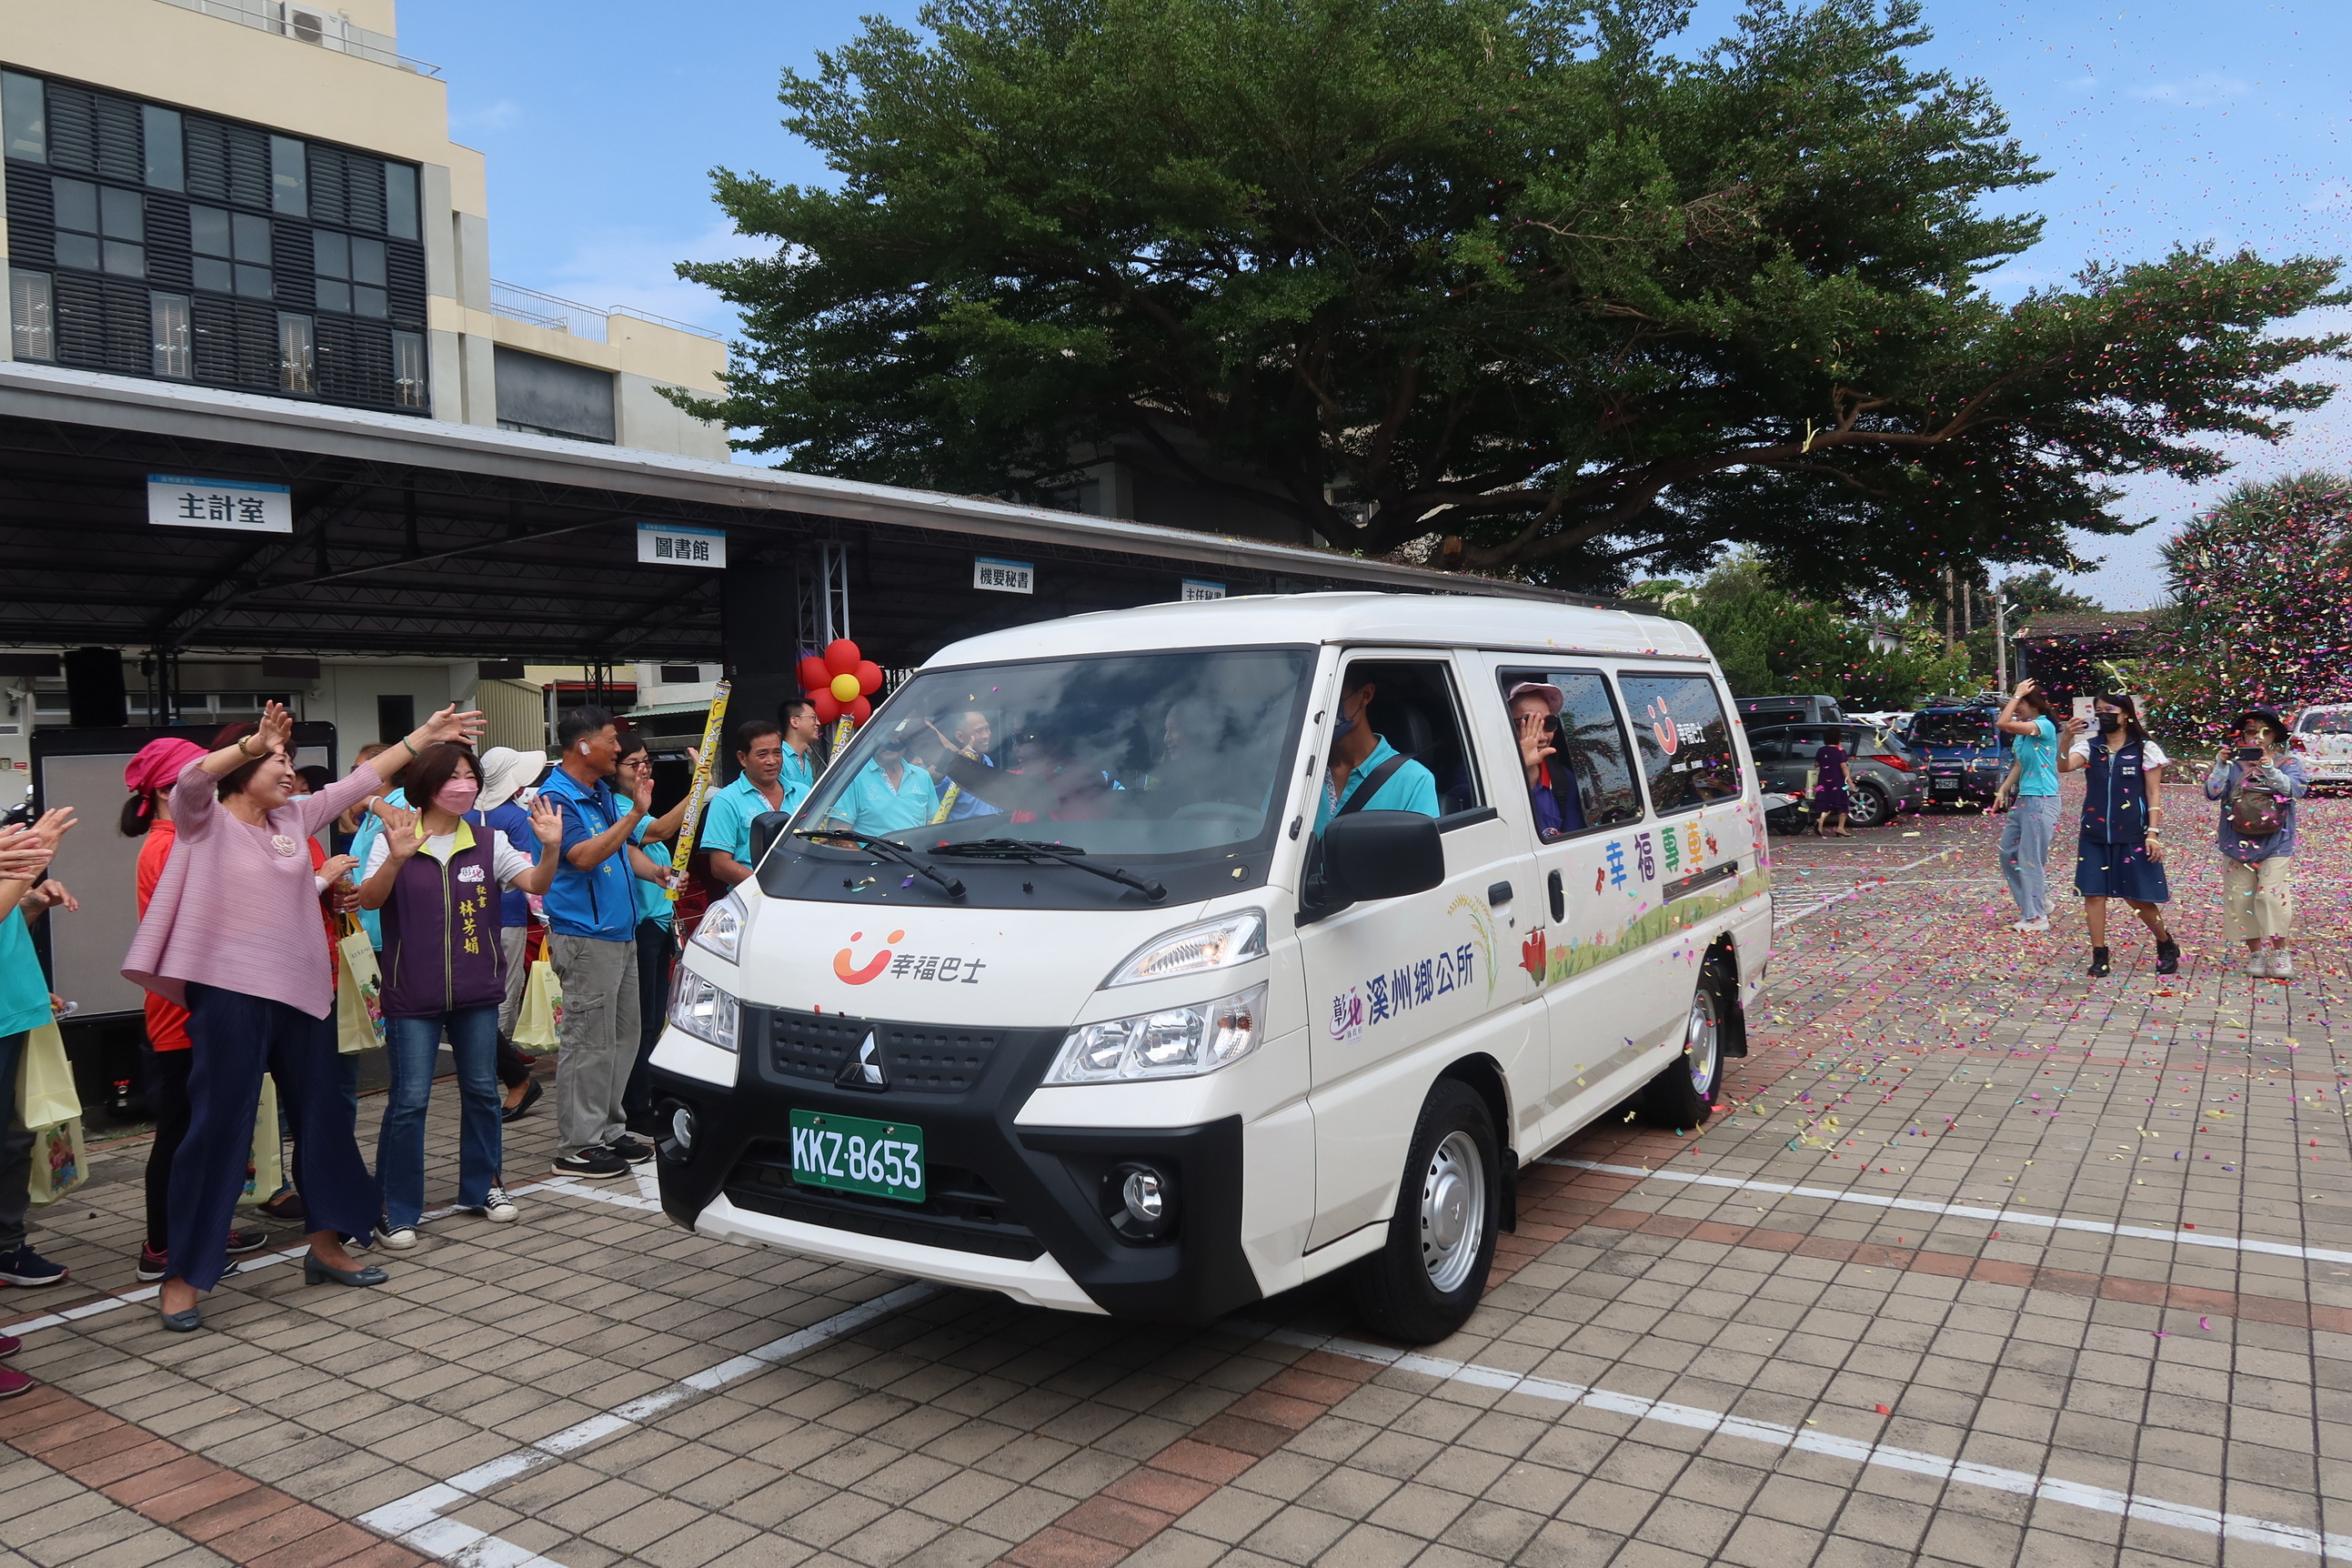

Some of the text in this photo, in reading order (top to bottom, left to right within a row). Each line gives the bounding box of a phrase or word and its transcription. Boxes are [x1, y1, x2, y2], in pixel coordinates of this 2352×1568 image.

[177, 492, 266, 524] 主計室
[656, 537, 709, 561] 圖書館
[980, 567, 1029, 588] 機要秘書
[1605, 821, 1704, 890] 幸福專車
[476, 884, 487, 908] 秘書
[459, 899, 479, 955] 林芳娟
[890, 954, 987, 984] 幸福巴士
[1366, 942, 1473, 1026] 溪州鄉公所
